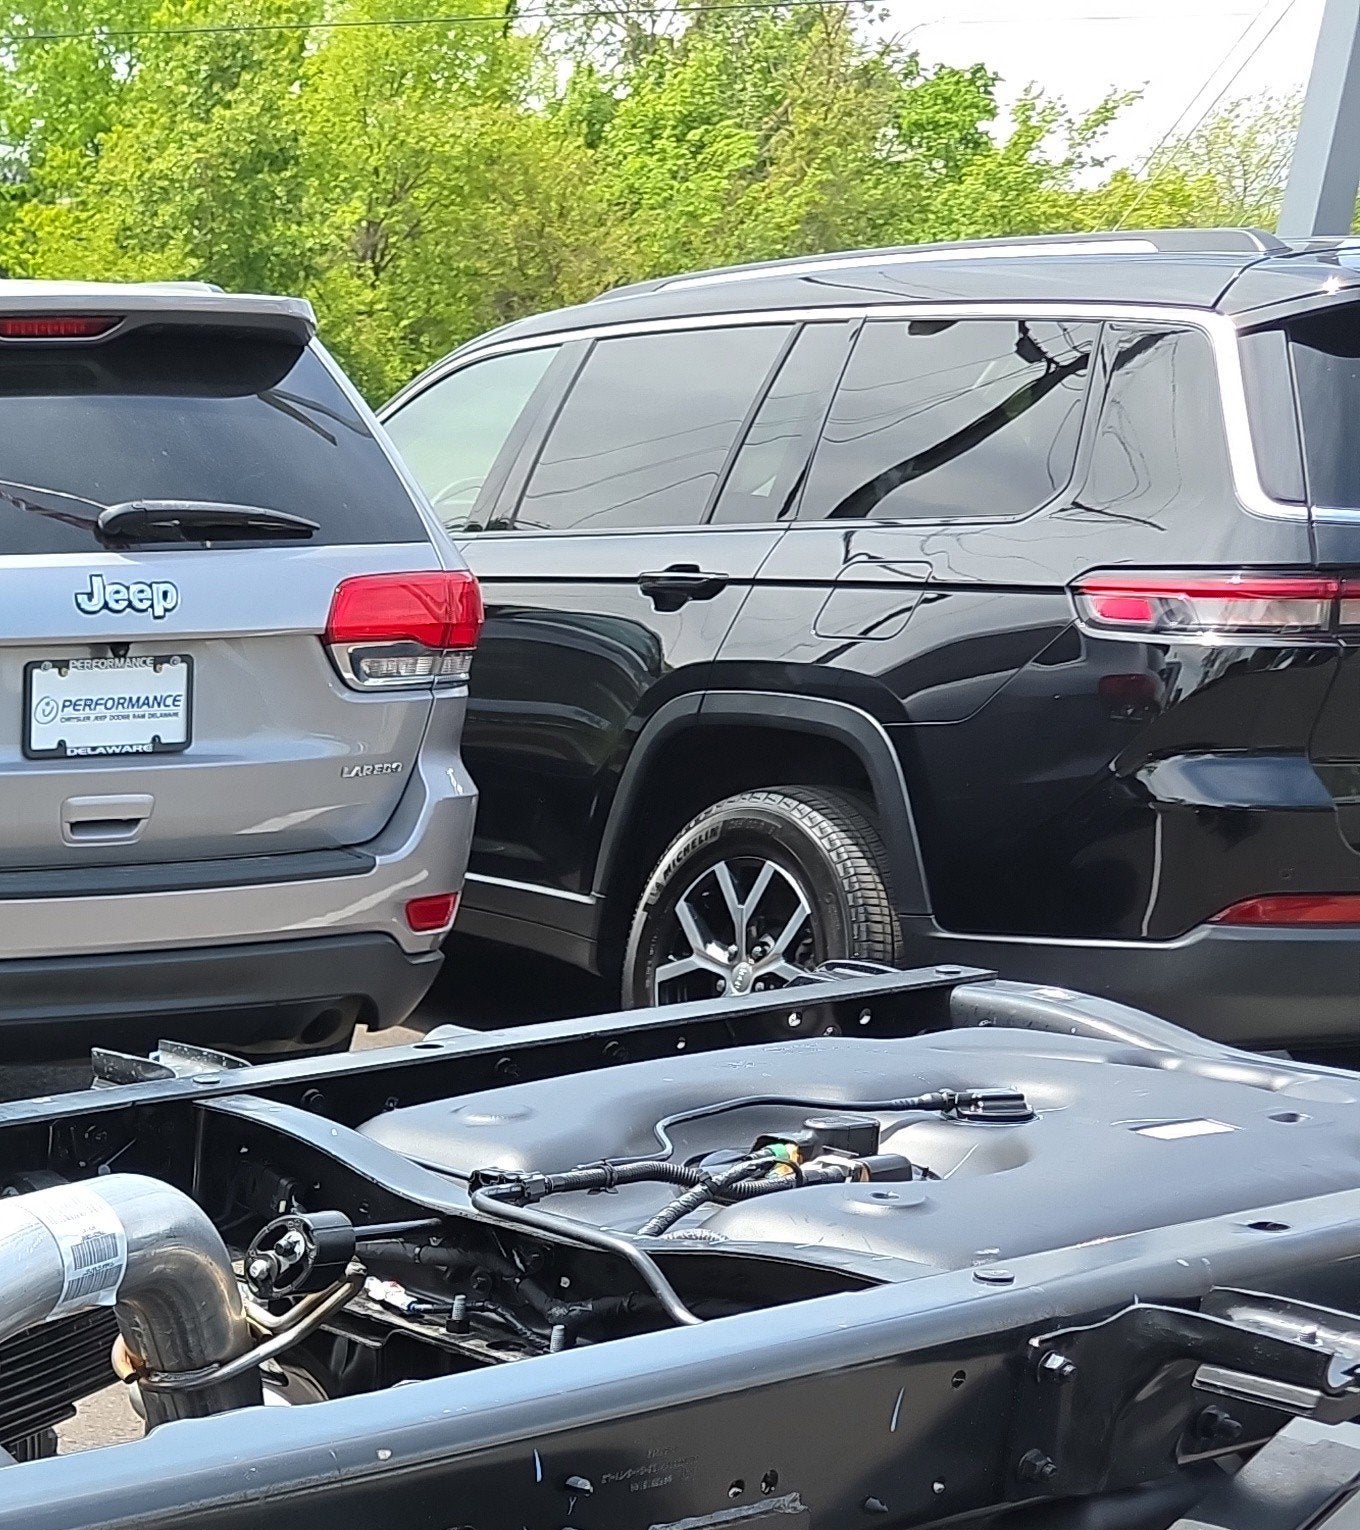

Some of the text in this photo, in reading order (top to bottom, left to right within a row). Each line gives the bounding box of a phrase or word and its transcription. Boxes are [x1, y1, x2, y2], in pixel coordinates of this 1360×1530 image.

[74, 573, 179, 620] Jeep
[69, 656, 155, 671] PERFORMANCE
[61, 694, 183, 713] PERFORMANCE
[66, 744, 154, 757] DELAWARE
[341, 762, 403, 778] LAREDO
[662, 825, 721, 881] MICHELIN
